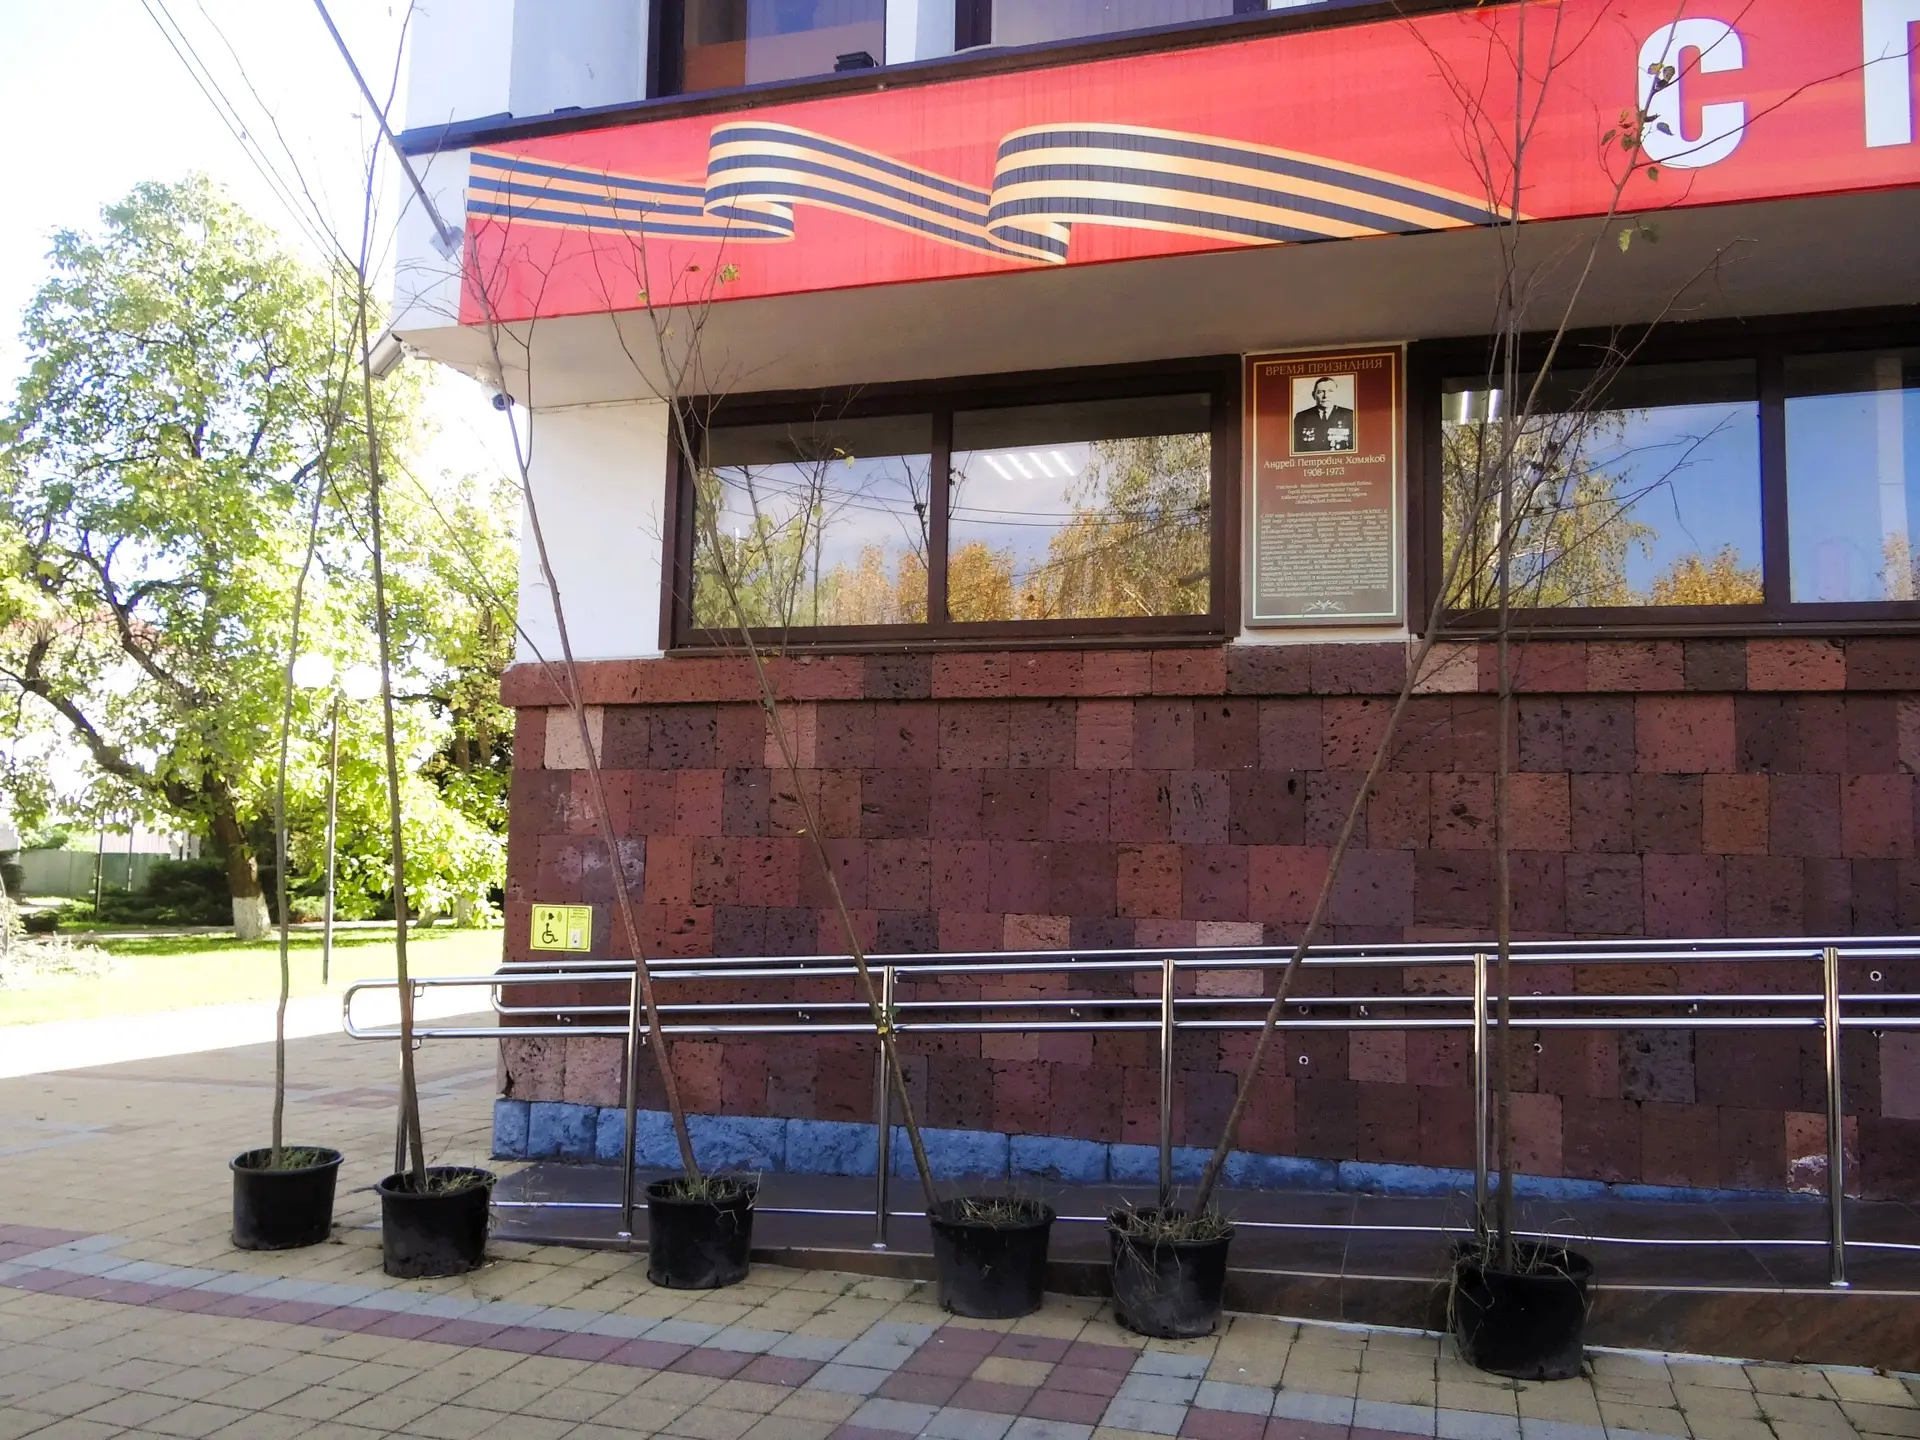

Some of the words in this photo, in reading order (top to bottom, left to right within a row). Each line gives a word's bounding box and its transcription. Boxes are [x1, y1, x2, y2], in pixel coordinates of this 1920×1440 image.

[1265, 364, 1304, 376] ВРЕМЯ
[1308, 359, 1383, 373] ПРИЗНАНИЯ
[1264, 459, 1295, 470] Андрей
[1297, 456, 1343, 468] Петрович
[1345, 454, 1386, 465] Хомяков
[1303, 467, 1345, 477] 1908-1973
